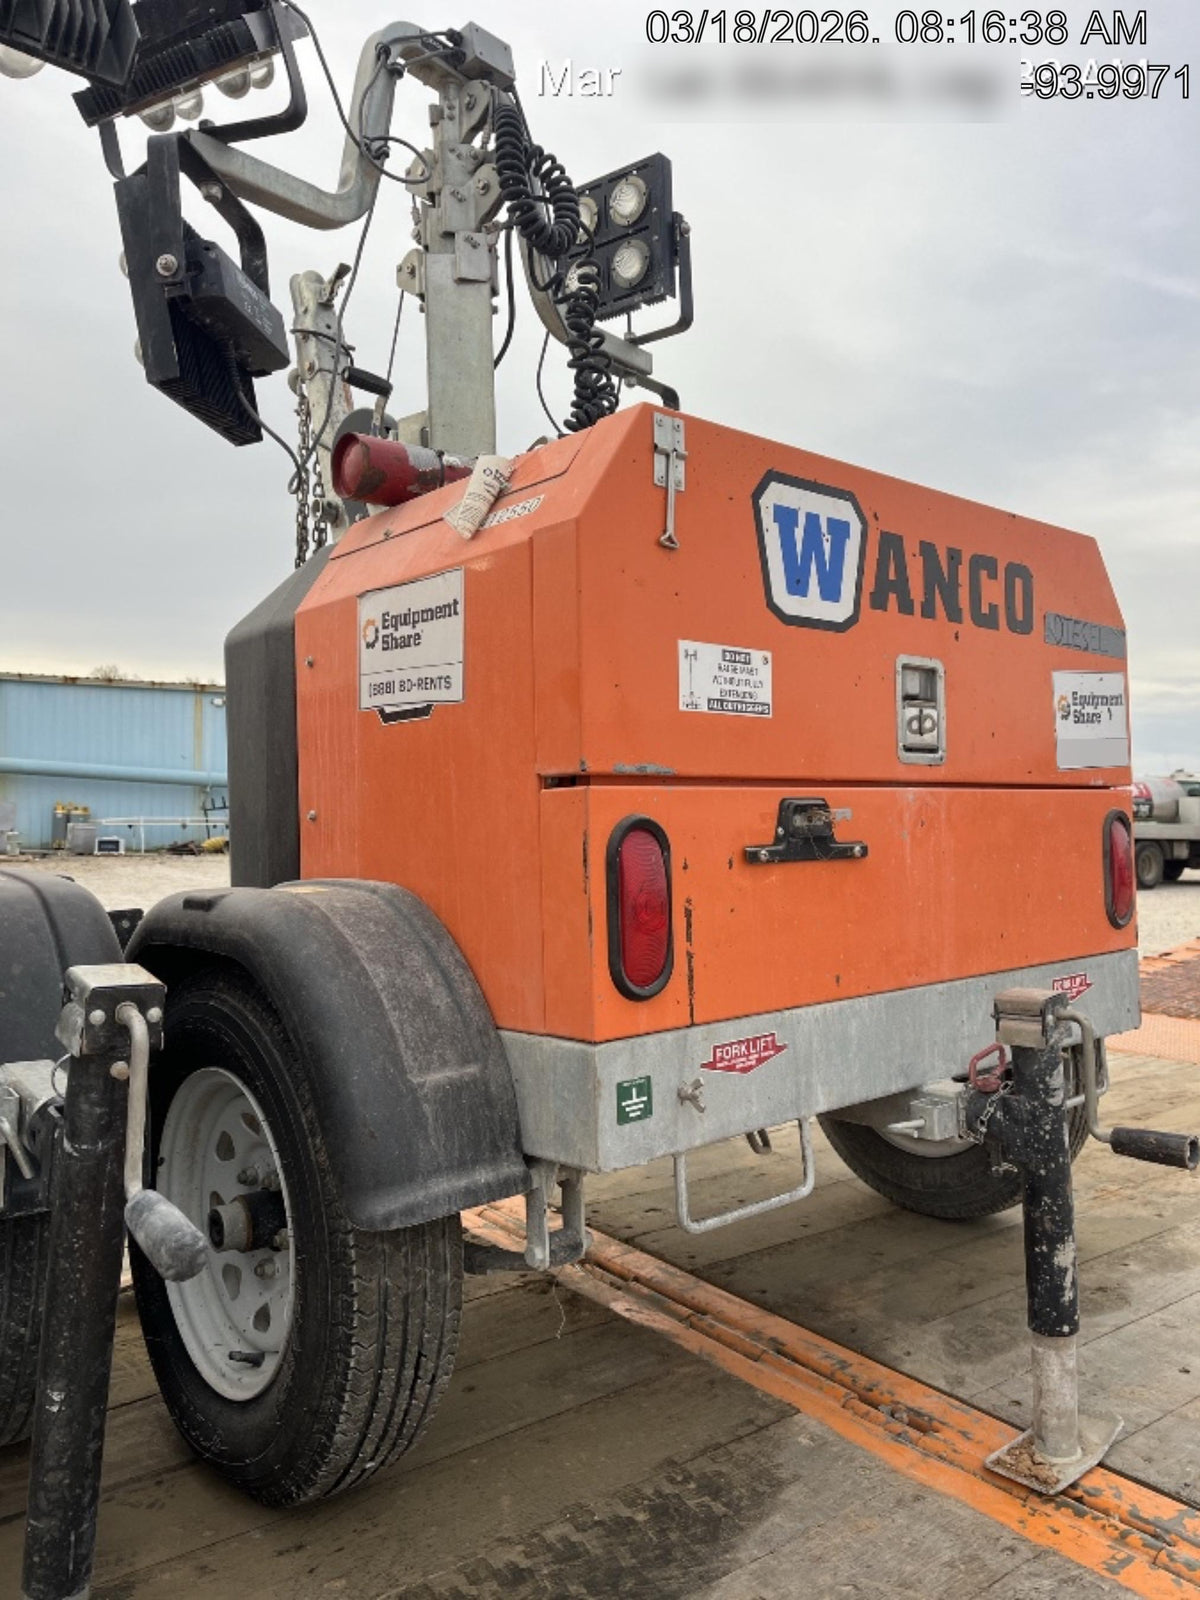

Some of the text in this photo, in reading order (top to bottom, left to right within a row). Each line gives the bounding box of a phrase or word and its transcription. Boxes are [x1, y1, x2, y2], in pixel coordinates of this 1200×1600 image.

[772, 502, 1034, 636] WANCO
[381, 598, 459, 632] Equipment
[381, 632, 422, 652] Share
[1072, 691, 1124, 710] Equipment
[1073, 708, 1102, 724] Share
